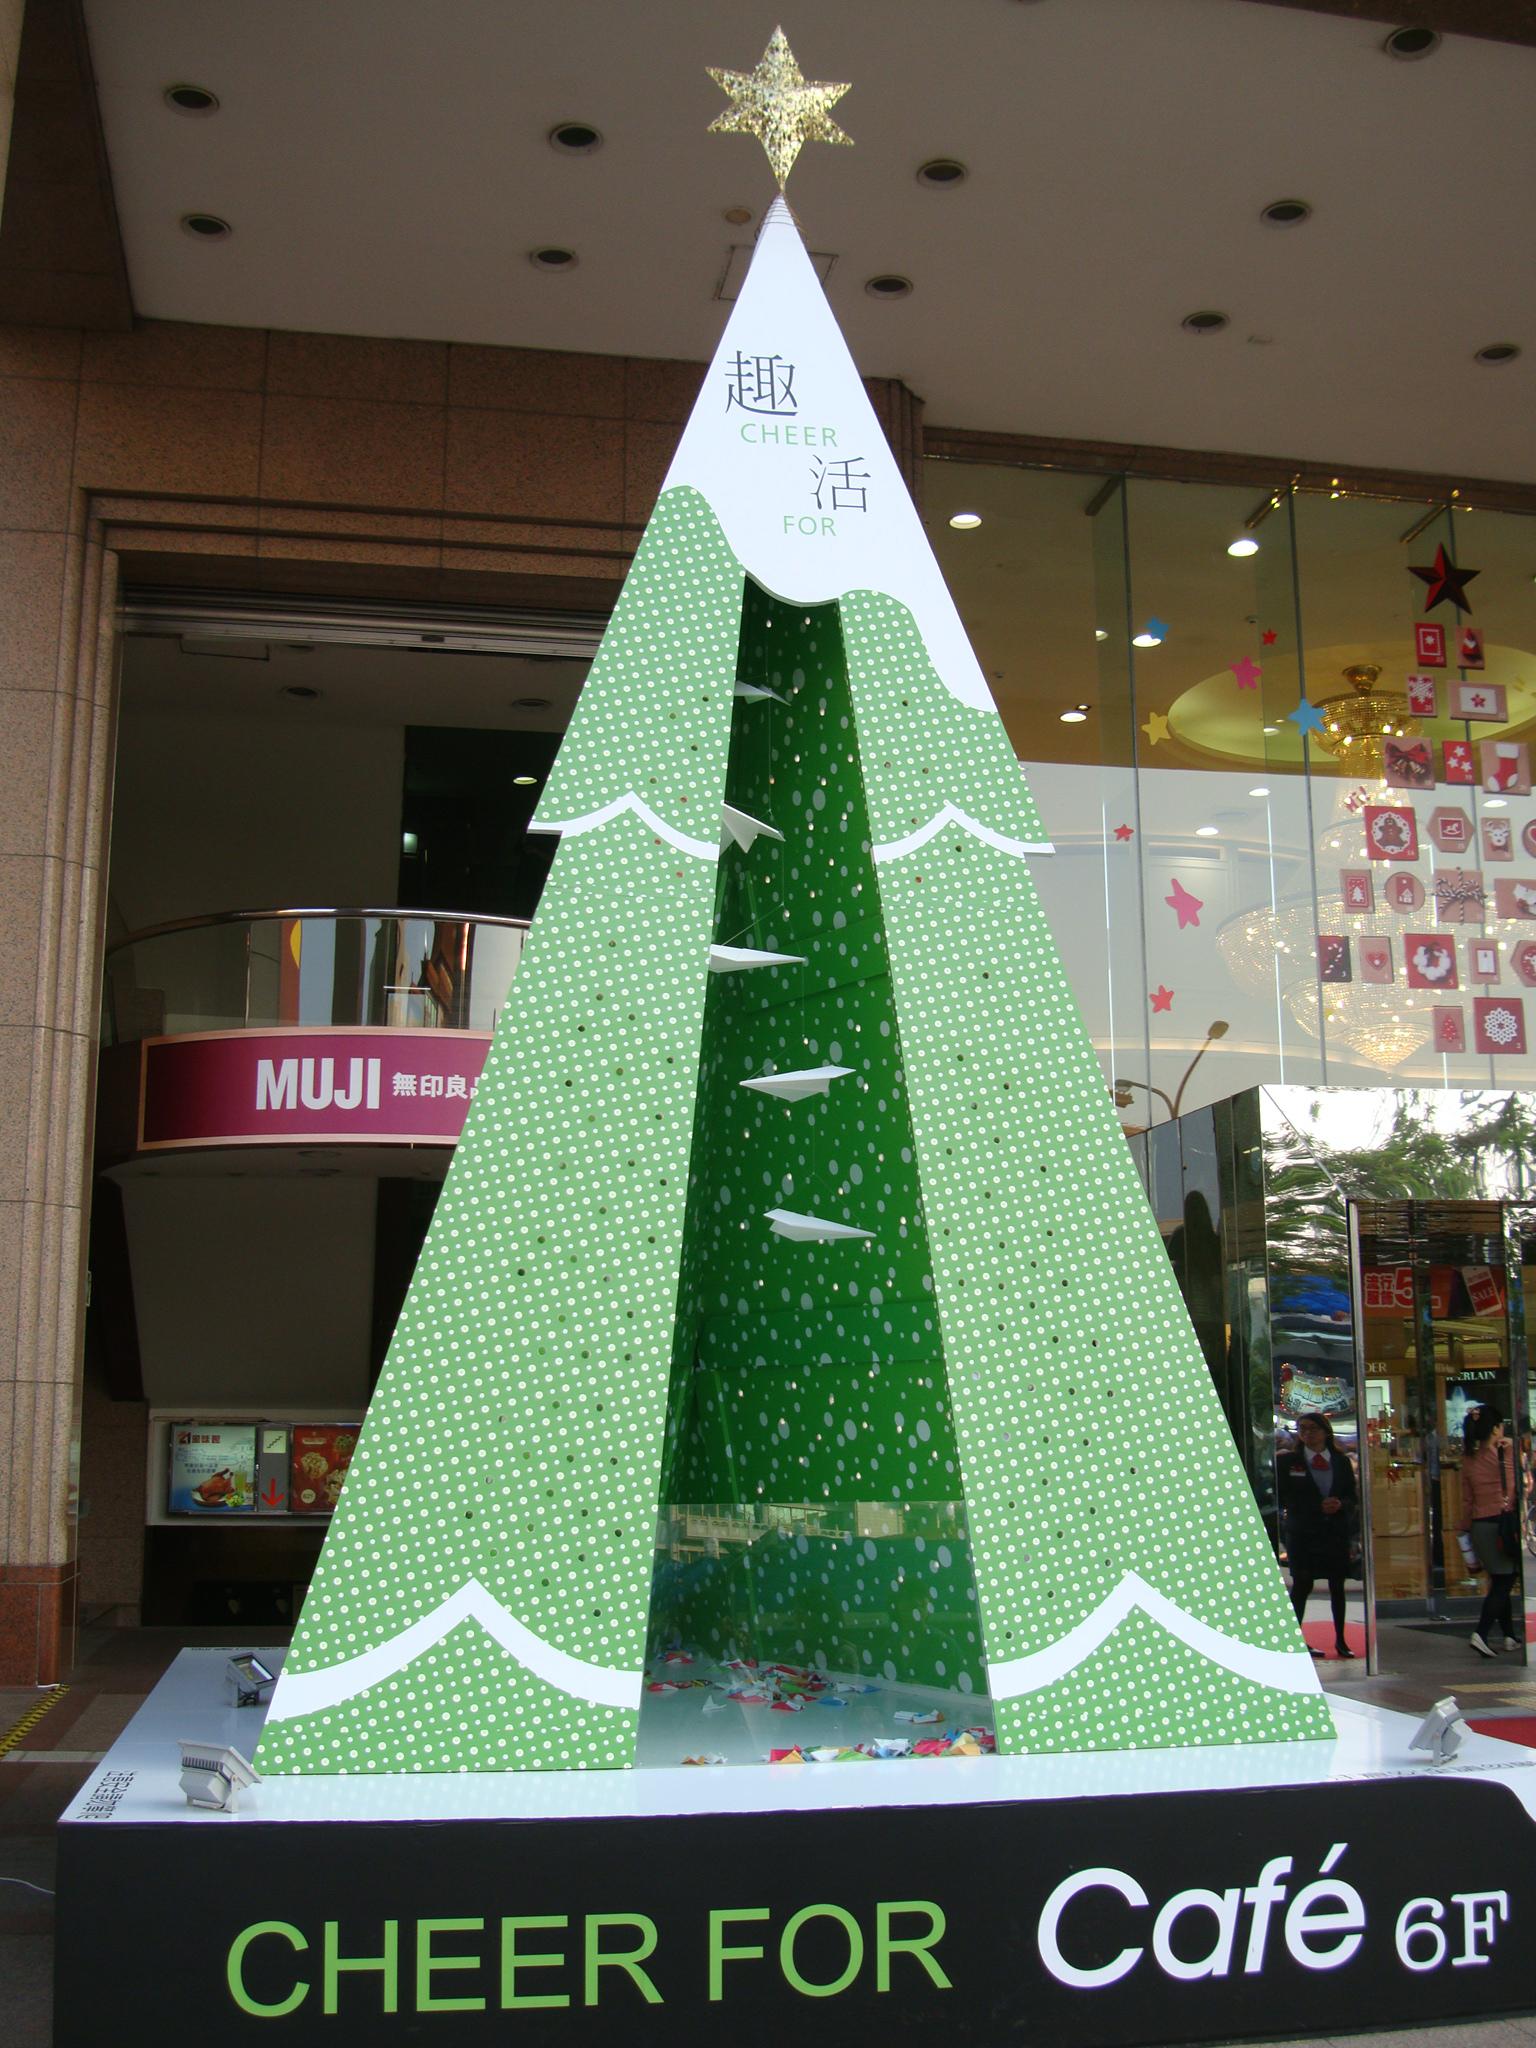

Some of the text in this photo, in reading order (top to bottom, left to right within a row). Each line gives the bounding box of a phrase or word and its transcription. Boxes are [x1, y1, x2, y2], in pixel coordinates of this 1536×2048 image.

[725, 351, 798, 416] 趣
[740, 423, 838, 447] CHEER
[809, 454, 871, 513] 活
[783, 515, 837, 537] FOR
[257, 1058, 381, 1110] MUJI
[227, 1843, 1508, 2018] CHEER FOR Café 6F
